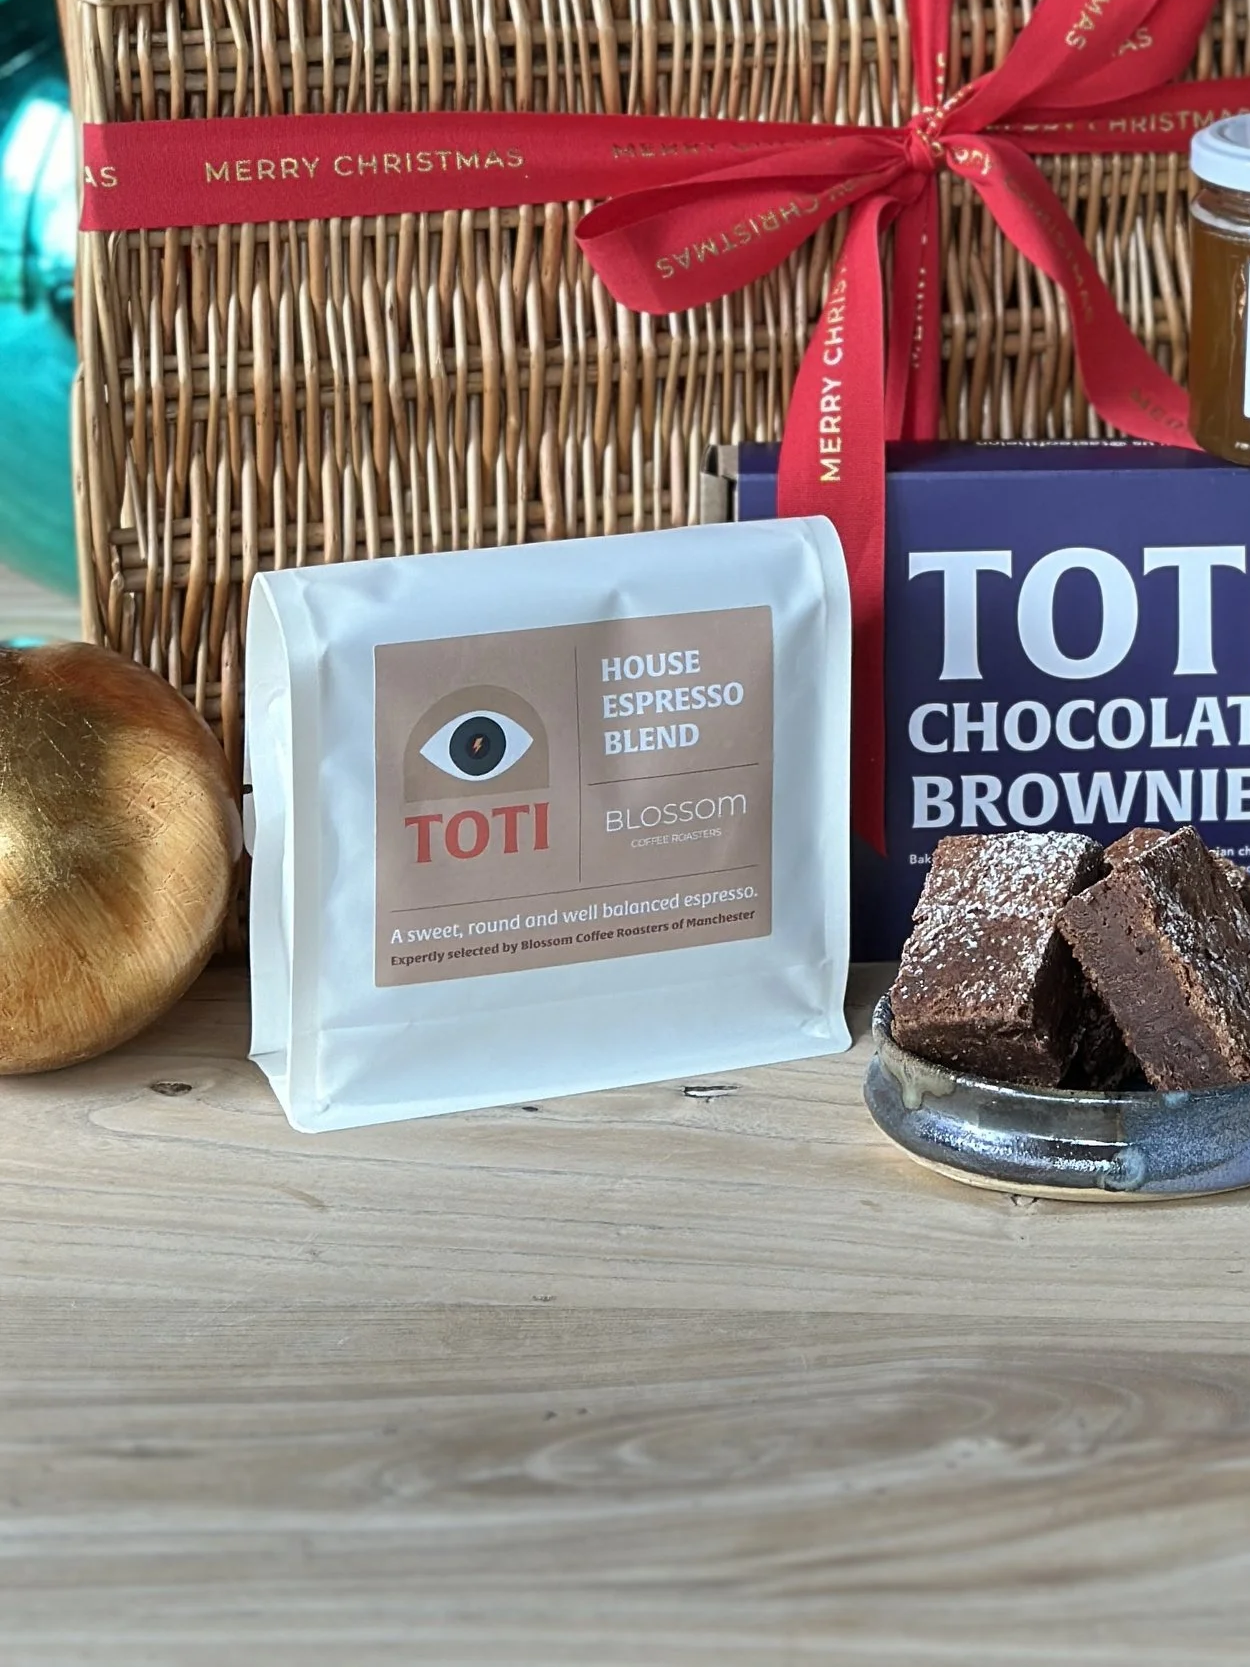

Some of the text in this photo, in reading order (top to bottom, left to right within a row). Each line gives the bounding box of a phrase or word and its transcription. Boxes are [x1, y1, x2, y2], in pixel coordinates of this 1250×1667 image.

[204, 148, 525, 183] MERRY CHRISTMAS
[656, 192, 820, 279] CHRISTMAS
[819, 267, 848, 482] MERRY CHRIS
[601, 649, 701, 682] HOUSE
[602, 682, 744, 719] ESPRESSO
[604, 723, 700, 755] BLEND
[404, 801, 550, 863] TOTI
[631, 828, 722, 848] COFFEE ROASTERS
[909, 853, 931, 864] Bak
[391, 886, 759, 944] A sweet, round and well balanced espresso.
[391, 910, 755, 966] Expertly selected by Blossom Coffee Roasters of Manchester
